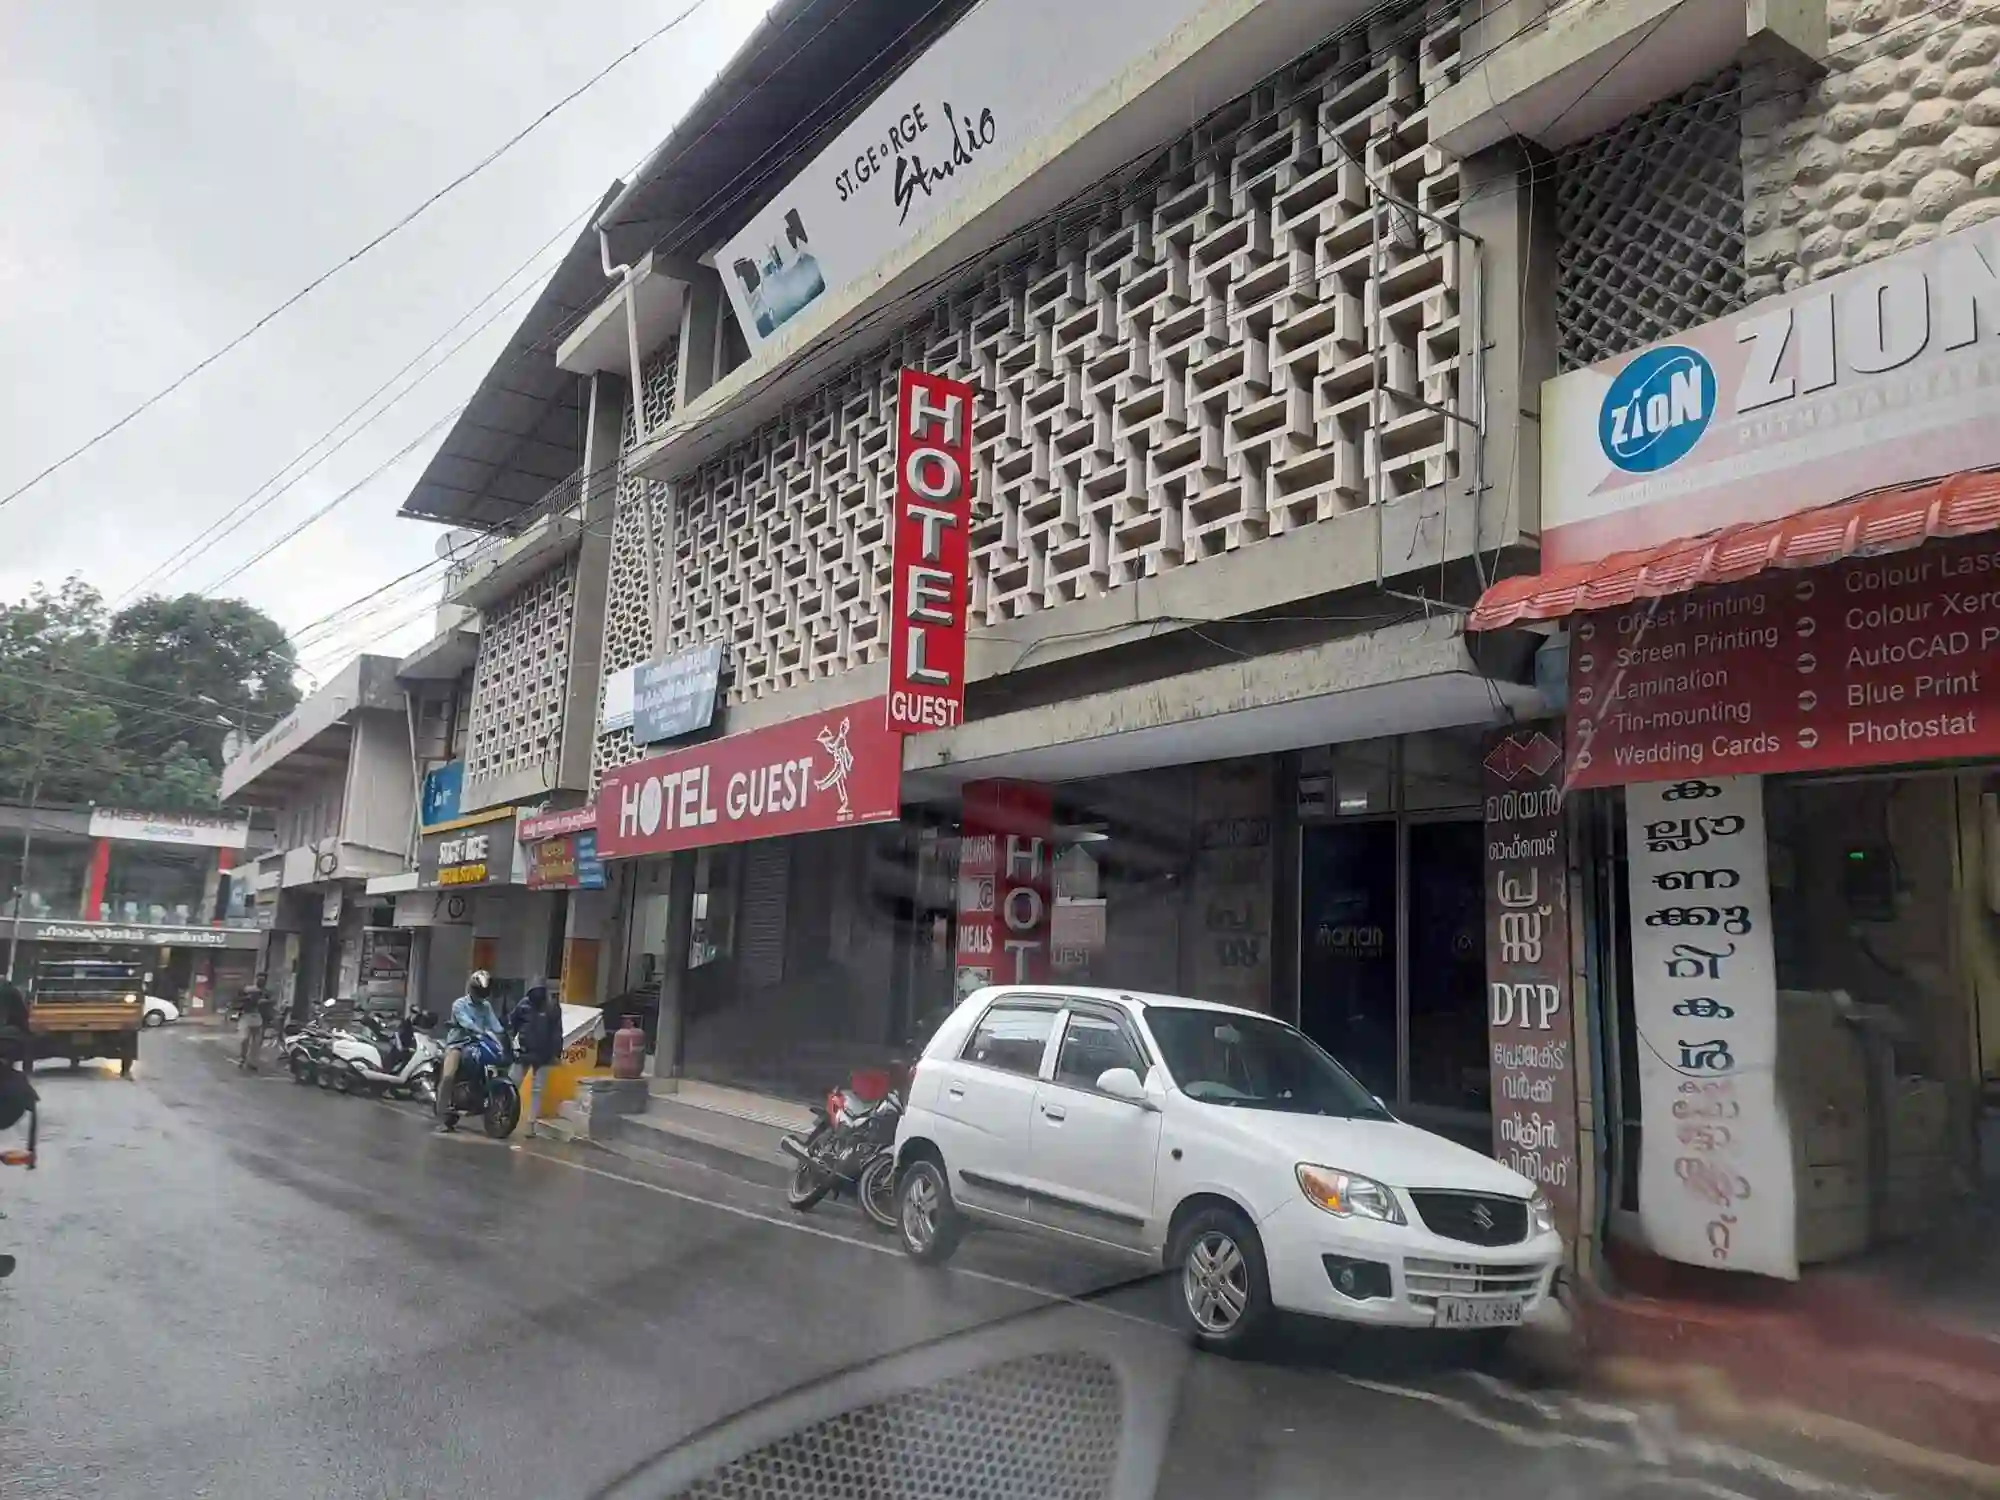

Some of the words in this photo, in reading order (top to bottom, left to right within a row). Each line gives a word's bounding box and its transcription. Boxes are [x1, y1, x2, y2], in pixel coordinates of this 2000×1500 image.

[894, 101, 996, 226] Studio
[906, 383, 963, 686] HOTEL
[1846, 561, 1933, 593] Colour
[1683, 593, 1766, 623] Printing
[1846, 601, 1933, 631] Colour
[1616, 641, 1687, 668] Screen
[1694, 626, 1779, 655] Printing
[1846, 631, 1970, 669] AutoCAD
[1613, 668, 1728, 700] Lamination
[1847, 682, 1905, 707] Blue
[1915, 670, 1980, 698] Print
[891, 691, 959, 727] GUEST
[1615, 701, 1751, 734] Tin-mounting
[1848, 709, 1977, 746] Photostat
[1613, 739, 1704, 767] Wedding
[1711, 730, 1781, 757] Cards
[618, 765, 718, 838] HOTEL
[726, 756, 813, 820] GUEST
[959, 925, 993, 954] MEALS
[1491, 982, 1560, 1030] DTP
